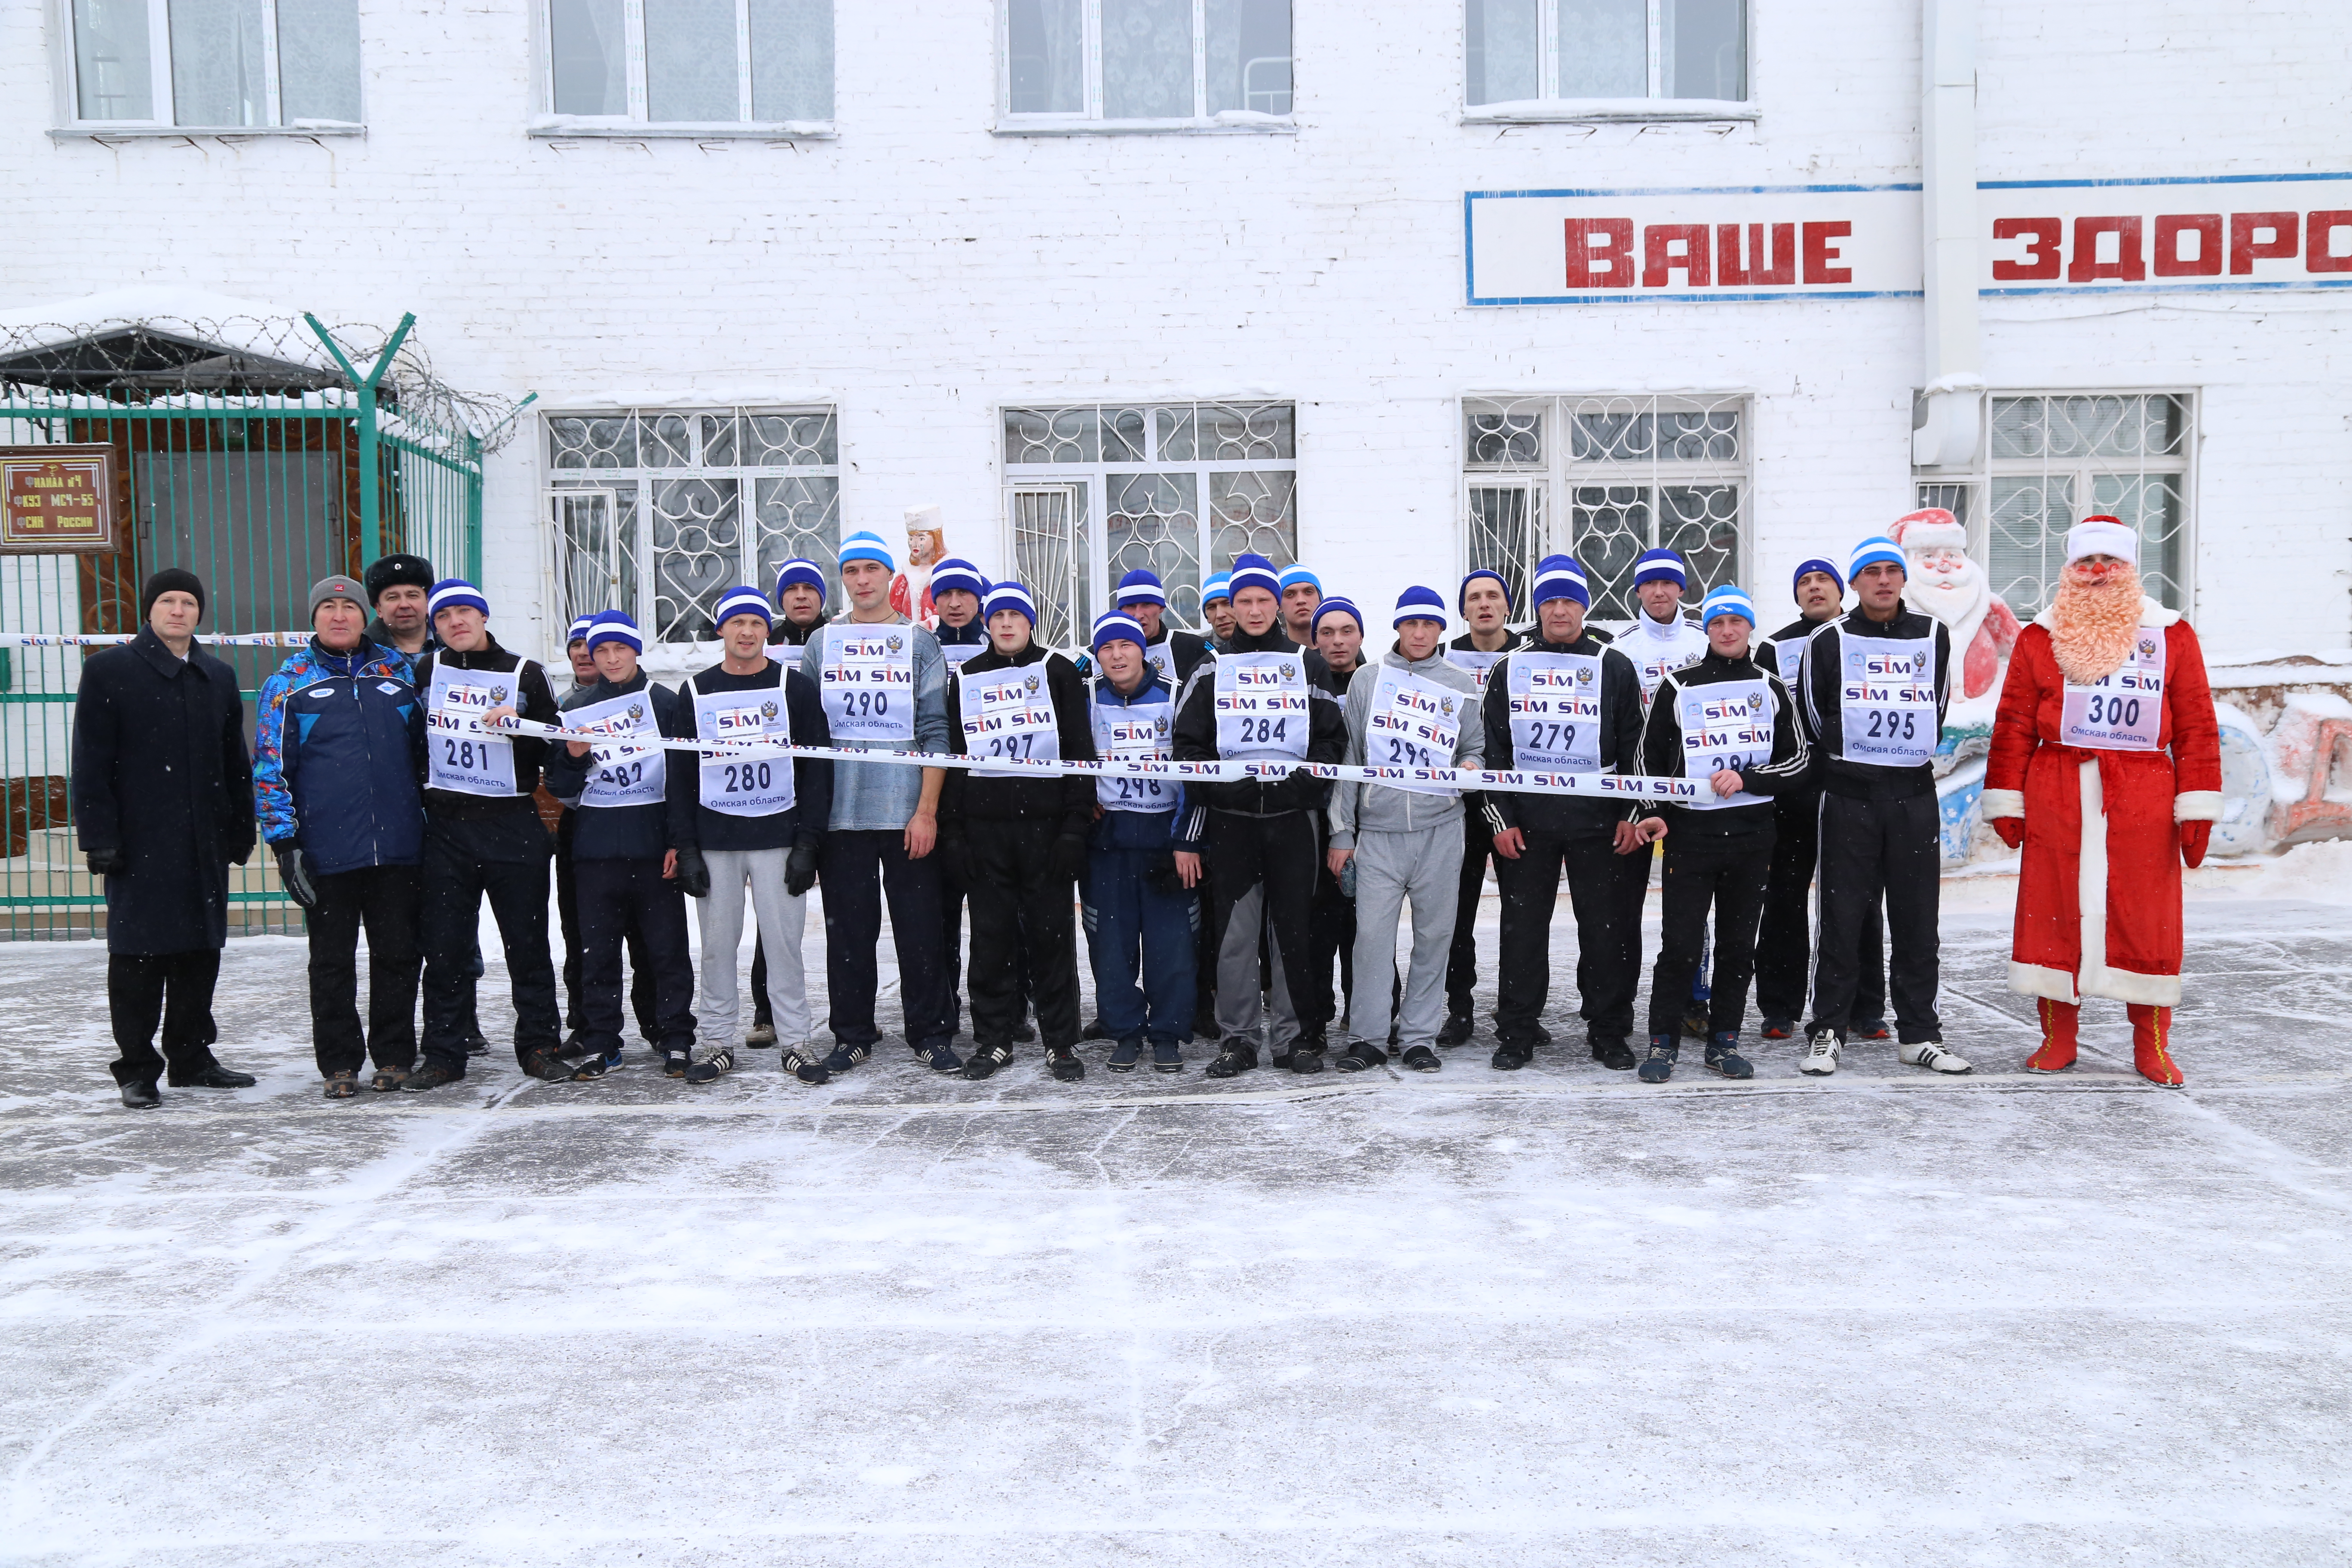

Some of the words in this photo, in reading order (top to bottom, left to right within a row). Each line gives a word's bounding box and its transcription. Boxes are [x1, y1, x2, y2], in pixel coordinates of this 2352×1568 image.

[1564, 217, 1852, 288] ВАШЕ
[14, 495, 41, 508] ФКУЗ
[51, 494, 94, 506] МСЧ-55
[17, 516, 44, 528] ФСИН
[116, 634, 130, 645] Si
[844, 640, 884, 655] SiM
[824, 664, 861, 682] SiM
[871, 664, 910, 683] SiM
[1868, 655, 1910, 674] SiM
[1238, 668, 1277, 684] SiM
[1532, 669, 1573, 687] SiM
[2121, 670, 2160, 691] SiM
[447, 686, 487, 706] SiM
[983, 684, 1023, 704] SiM
[1217, 692, 1256, 710] SiM
[1267, 692, 1306, 710] SiM
[1846, 681, 1888, 701] SiM
[1899, 683, 1934, 702] SiM
[843, 692, 888, 717] 290
[1396, 692, 1436, 714] SiM
[1510, 694, 1547, 713] SiM
[1558, 695, 1598, 716] SiM
[1705, 700, 1747, 720] SiM
[2089, 695, 2139, 727] 300
[428, 710, 459, 730] SiM
[719, 710, 760, 729] SiM
[834, 720, 865, 728] Омская
[964, 715, 1002, 735] SiM
[1011, 707, 1050, 726] SiM
[1372, 710, 1409, 732] SiM
[1417, 724, 1455, 749] SiM
[1868, 710, 1914, 740] 295
[1113, 722, 1152, 741] SiM
[1240, 717, 1286, 743] 284
[1529, 722, 1575, 751] 279
[1685, 728, 1727, 749] SiM
[1738, 724, 1770, 743] SiM
[2071, 726, 2107, 738] Омская
[2110, 732, 2147, 742] область
[445, 738, 488, 771] 281
[486, 717, 521, 729] iM
[1127, 760, 1168, 772] SiM
[1179, 761, 1220, 775] SiM
[1245, 761, 1286, 776] SiM
[1363, 766, 1404, 778] SiM
[1415, 767, 1456, 781] SiM
[1482, 769, 1523, 784] SiM
[1534, 772, 1575, 787] SiM
[1601, 775, 1642, 792] SiM
[1653, 777, 1695, 796] SiM
[990, 734, 1033, 759] 297
[1389, 738, 1430, 767] 299
[1853, 742, 1888, 753] Омская
[1891, 746, 1927, 756] область
[1520, 753, 1552, 763] Омская
[1555, 756, 1592, 765] область
[436, 769, 465, 781] Омская
[468, 776, 506, 787] область
[725, 763, 771, 793] 280
[1117, 777, 1161, 799] 298
[619, 786, 655, 796] область
[750, 796, 786, 805] область
